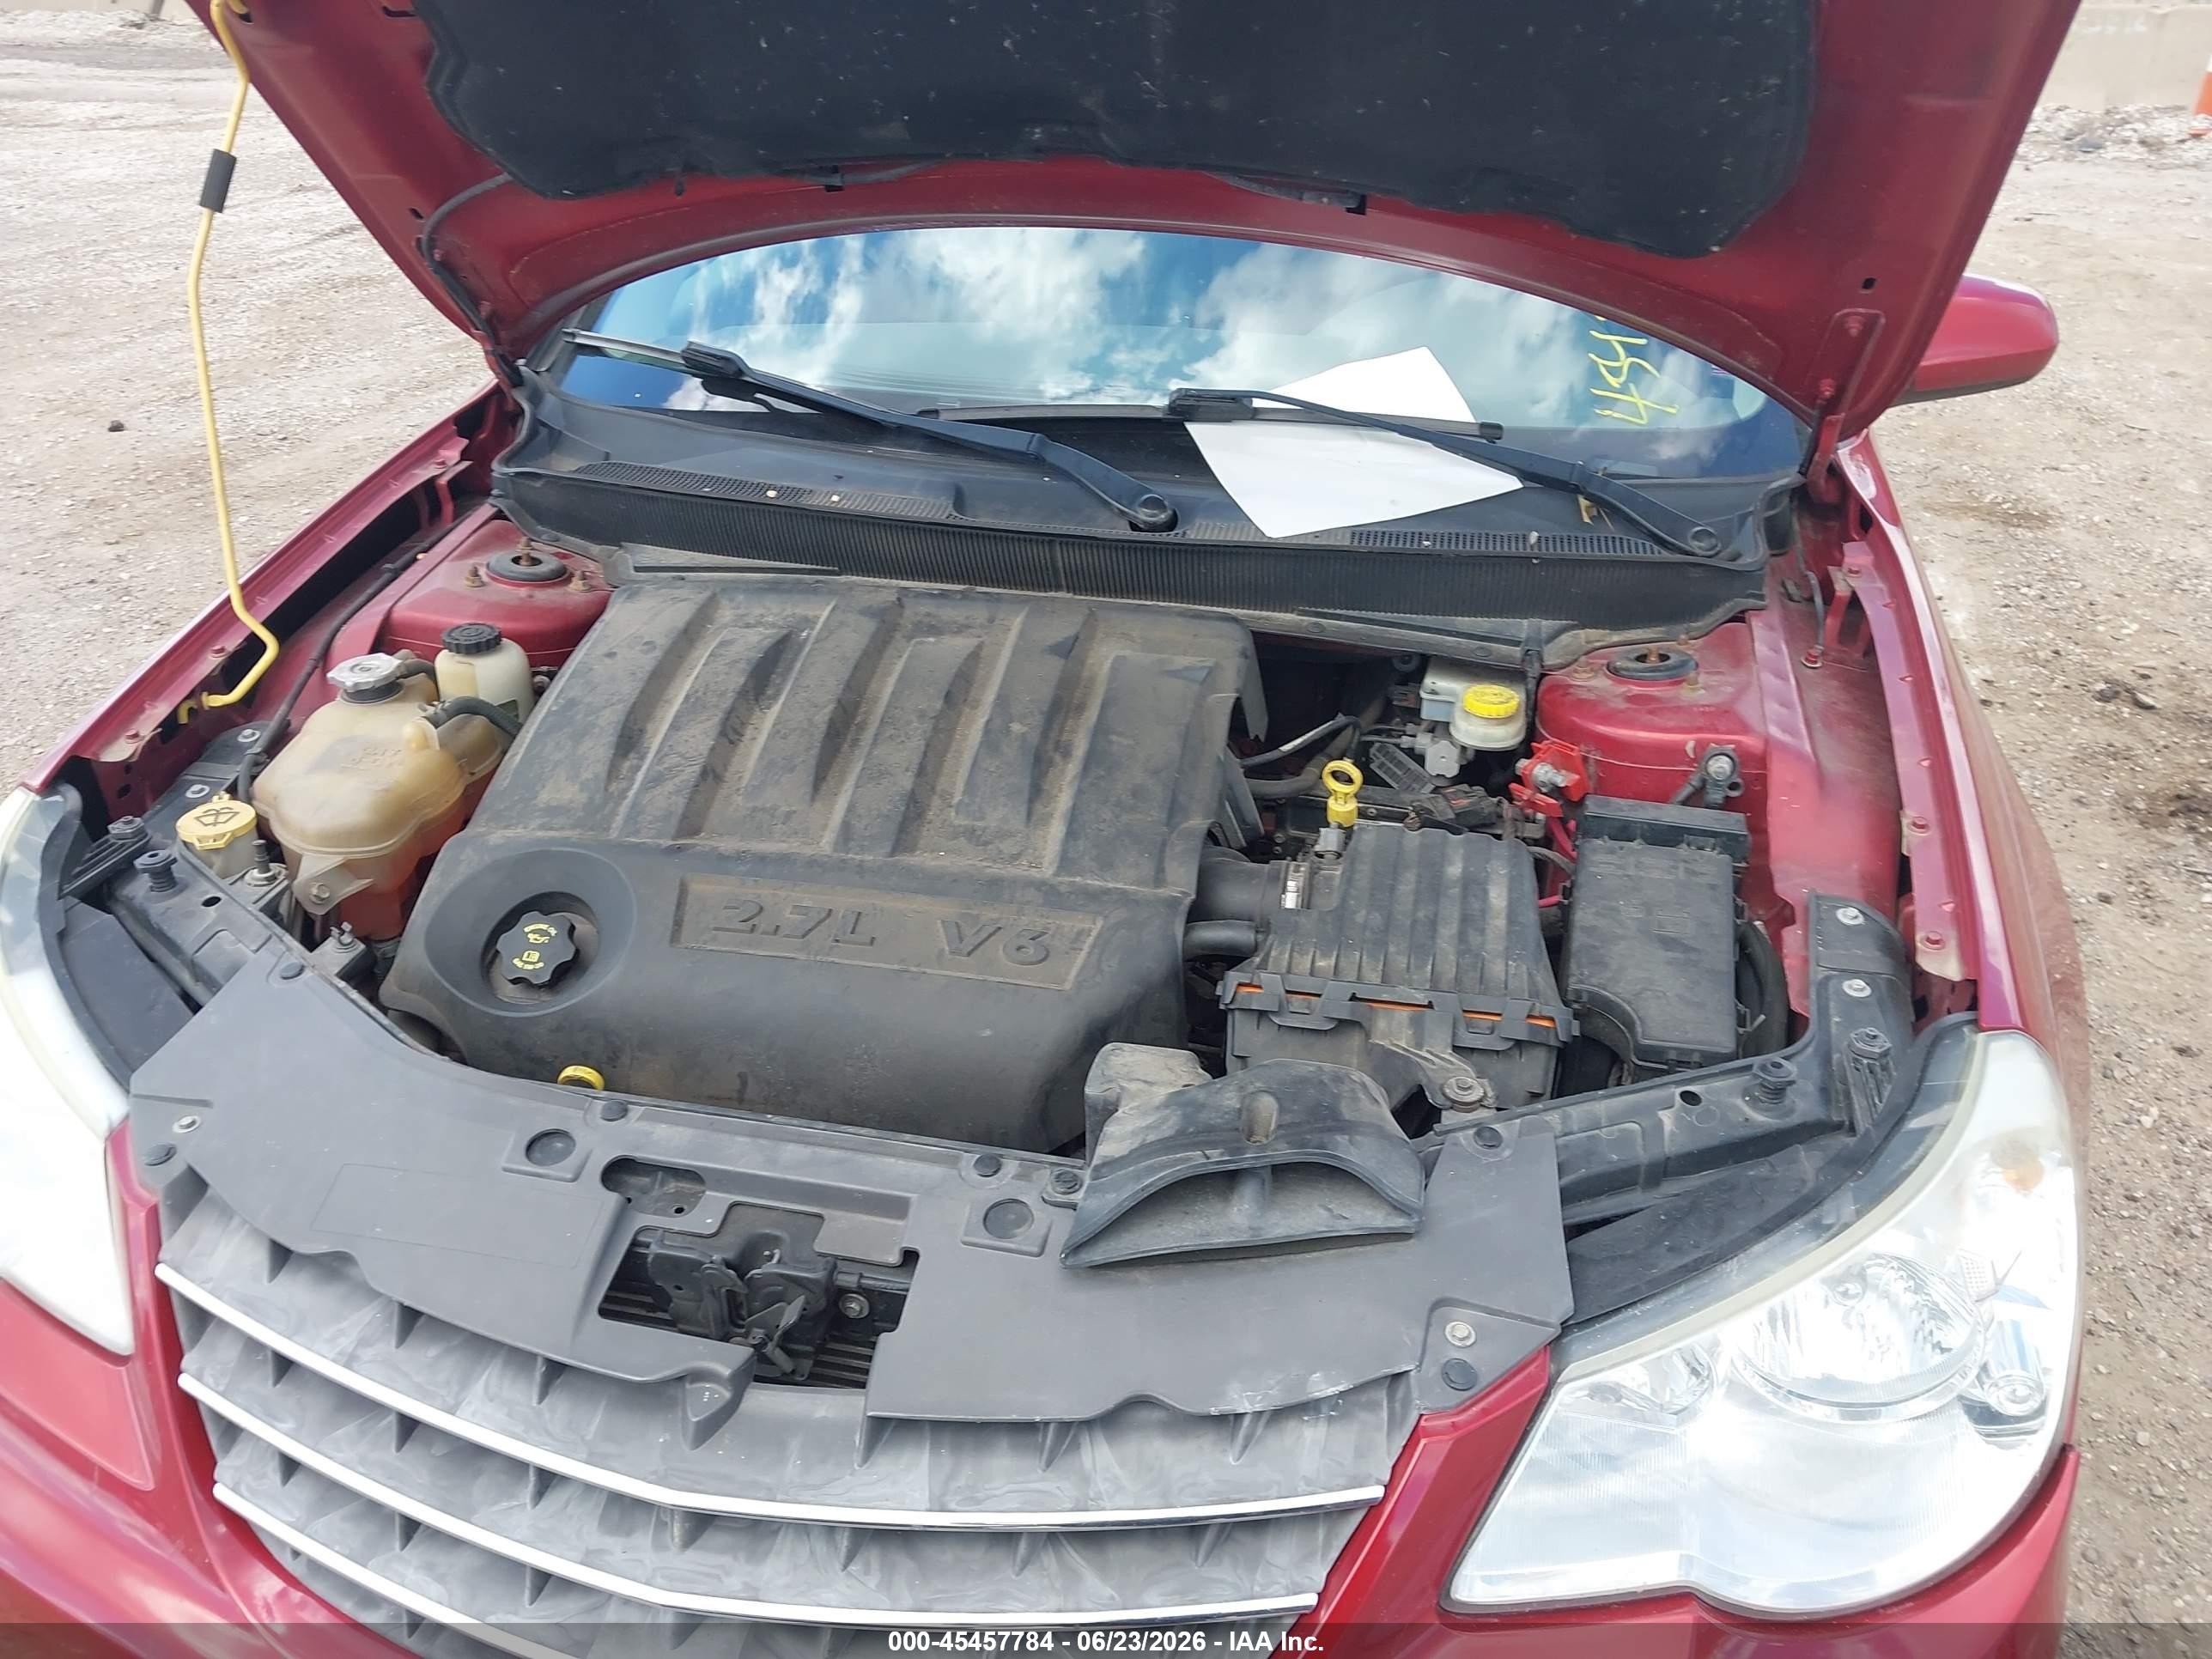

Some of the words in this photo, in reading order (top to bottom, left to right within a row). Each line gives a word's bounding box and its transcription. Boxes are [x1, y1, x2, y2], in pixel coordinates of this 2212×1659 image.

[1588, 315, 1680, 425] 454
[712, 899, 877, 947] 2.7L
[938, 919, 1051, 967] V6
